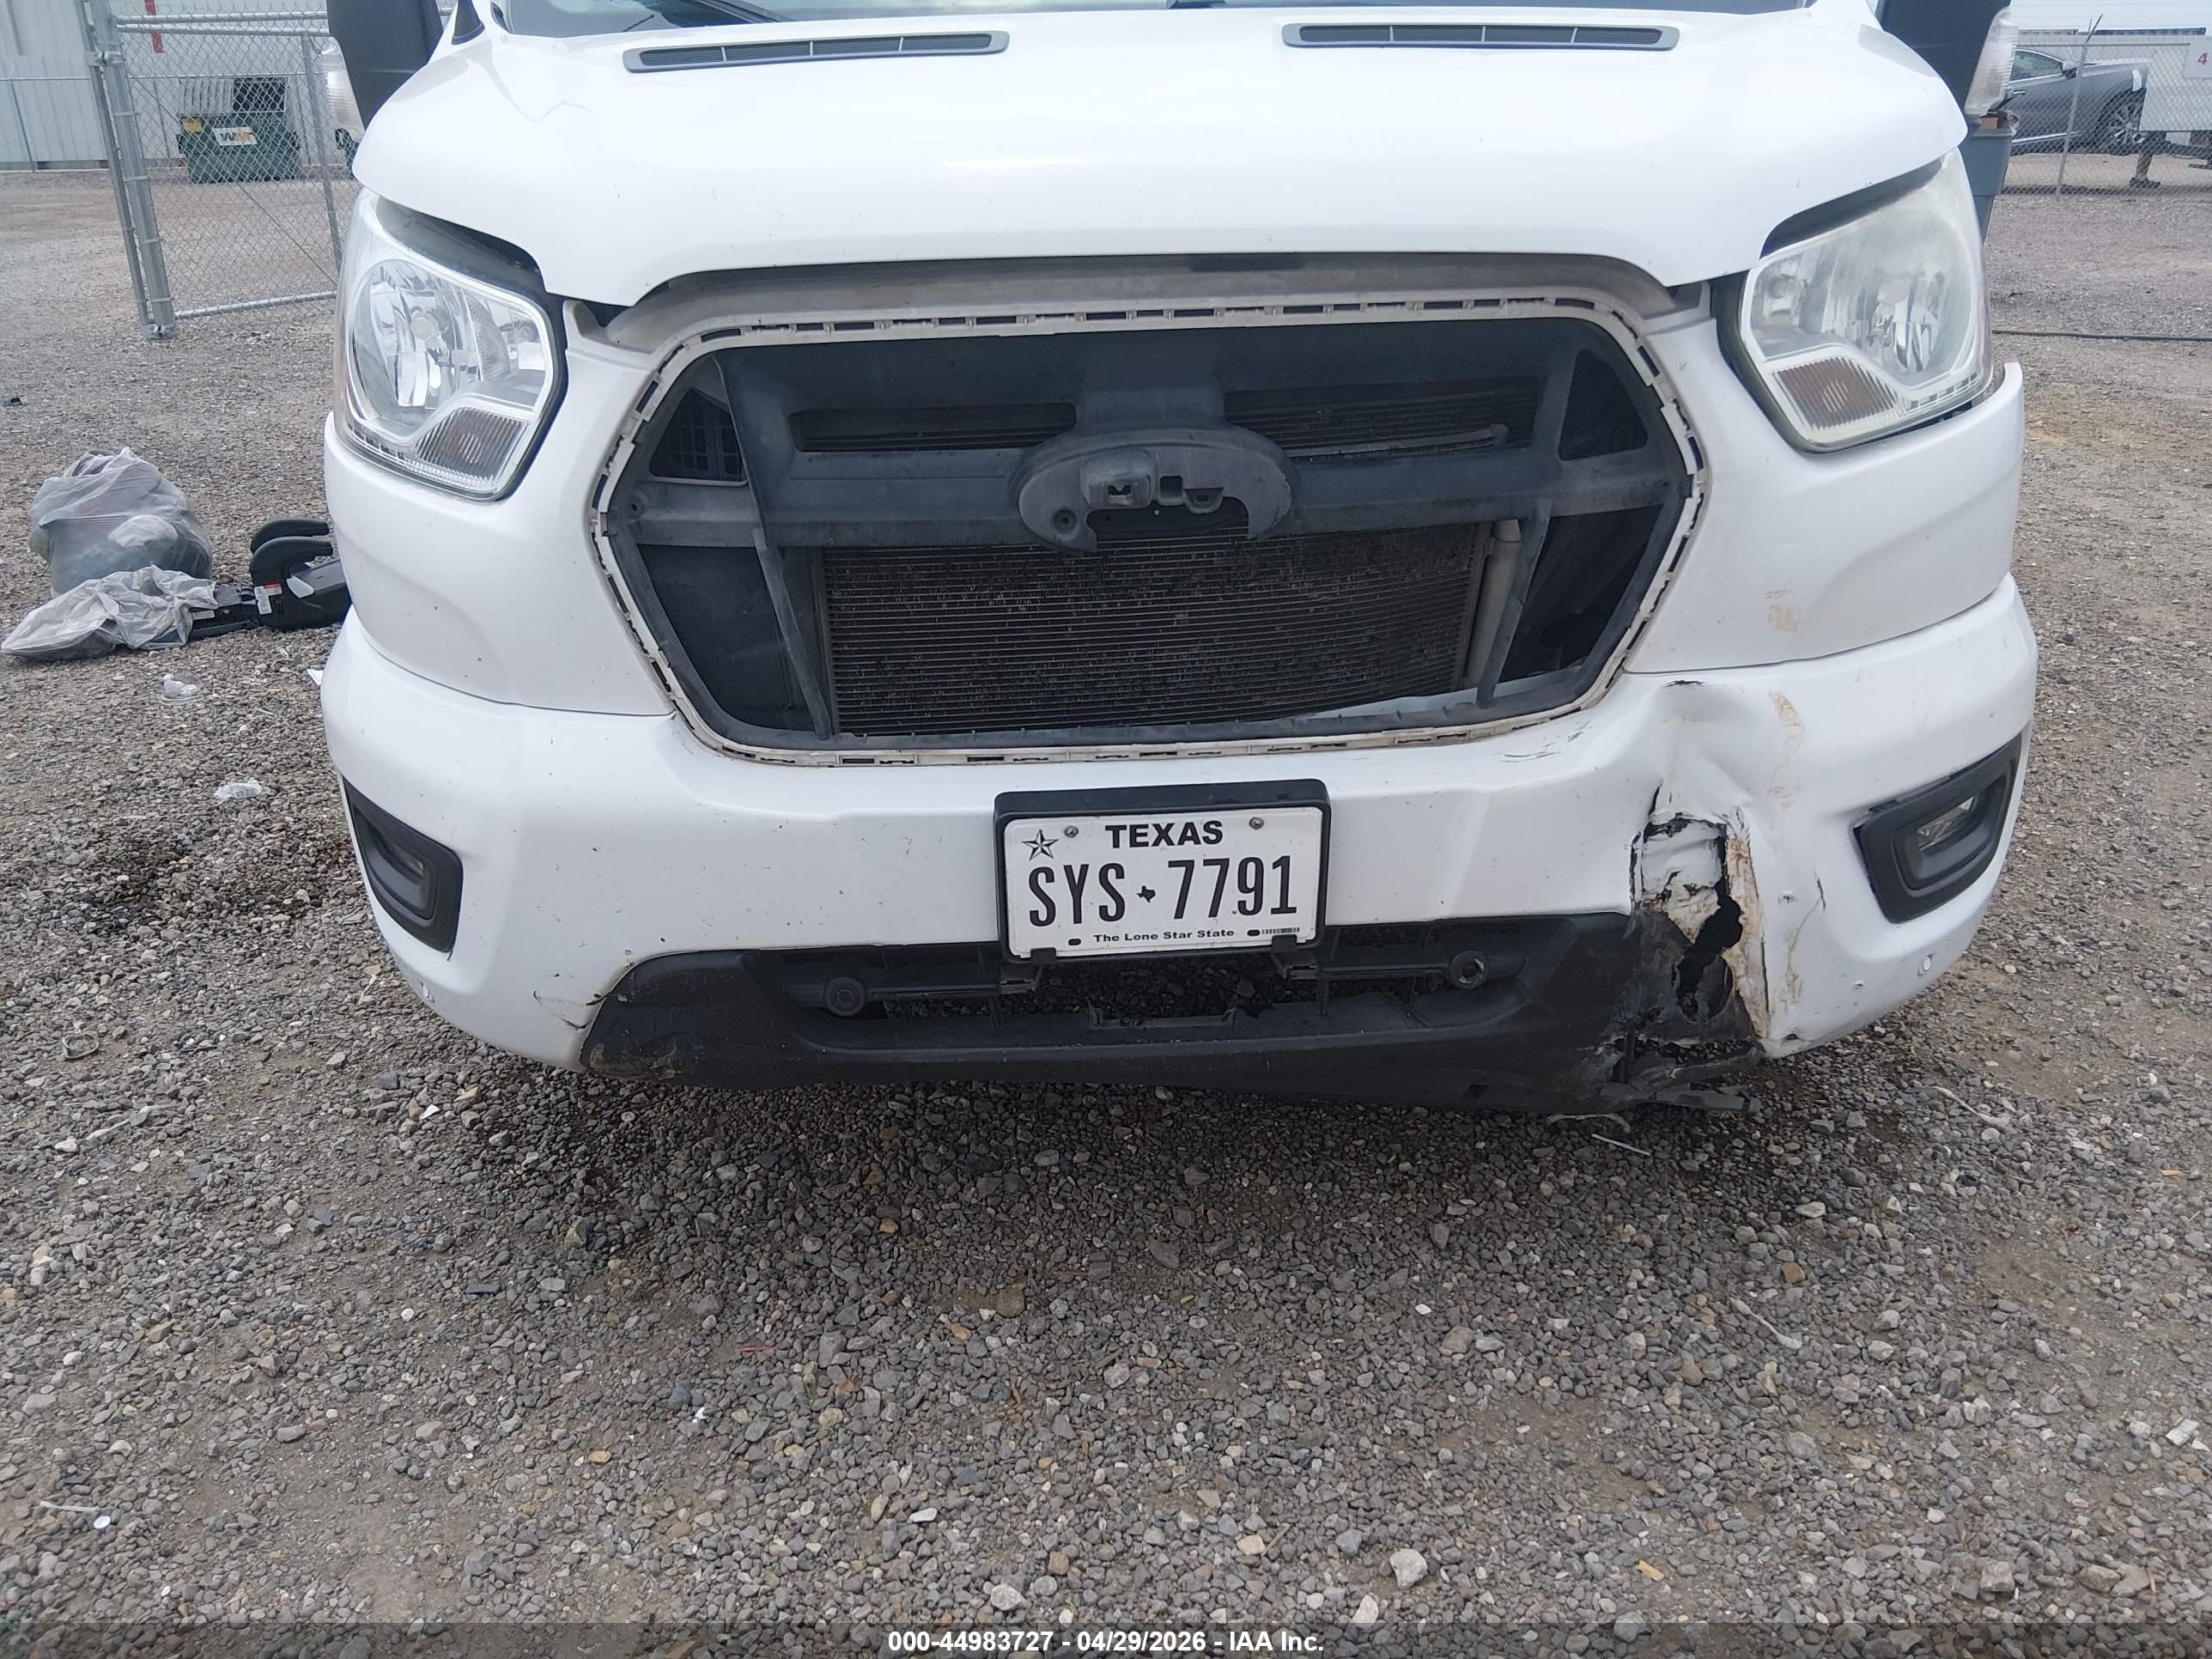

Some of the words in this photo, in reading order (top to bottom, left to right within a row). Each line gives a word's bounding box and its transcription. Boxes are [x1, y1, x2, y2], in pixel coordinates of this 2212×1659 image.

[1105, 820, 1224, 848] TEXAS
[1029, 863, 1126, 927] SYS
[1168, 855, 1297, 920] 7791
[1094, 933, 1121, 943] The
[1124, 931, 1159, 941] Lone
[1164, 930, 1193, 940] Star
[1197, 928, 1235, 939] State
